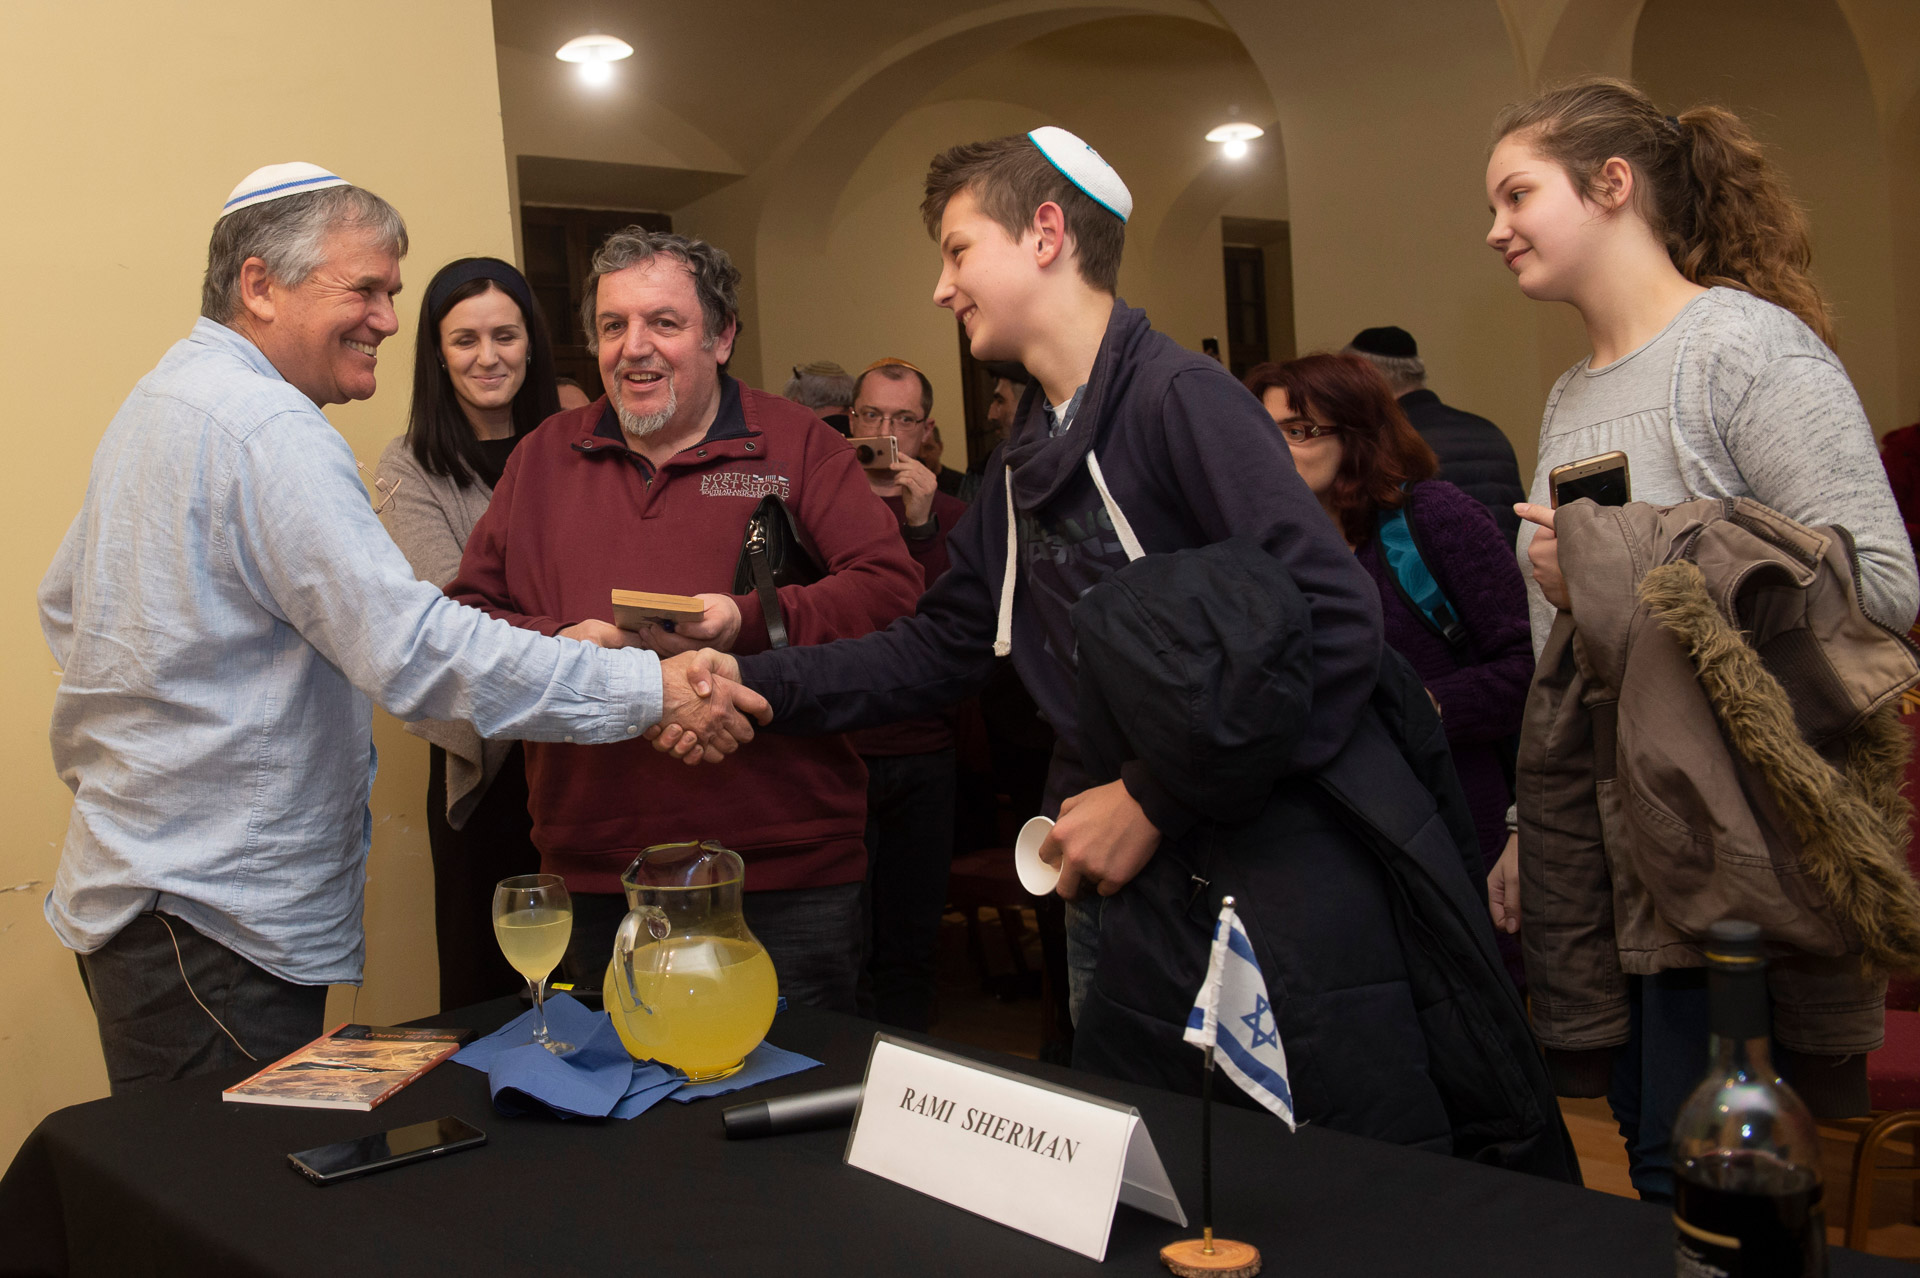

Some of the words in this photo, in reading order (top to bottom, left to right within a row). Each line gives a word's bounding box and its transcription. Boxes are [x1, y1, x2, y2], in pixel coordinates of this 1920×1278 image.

[701, 472, 751, 485] NORTH
[699, 480, 739, 491] EAST
[741, 482, 791, 498] SHORE
[899, 1087, 957, 1123] RAMI
[961, 1107, 1081, 1164] SHERMAN
